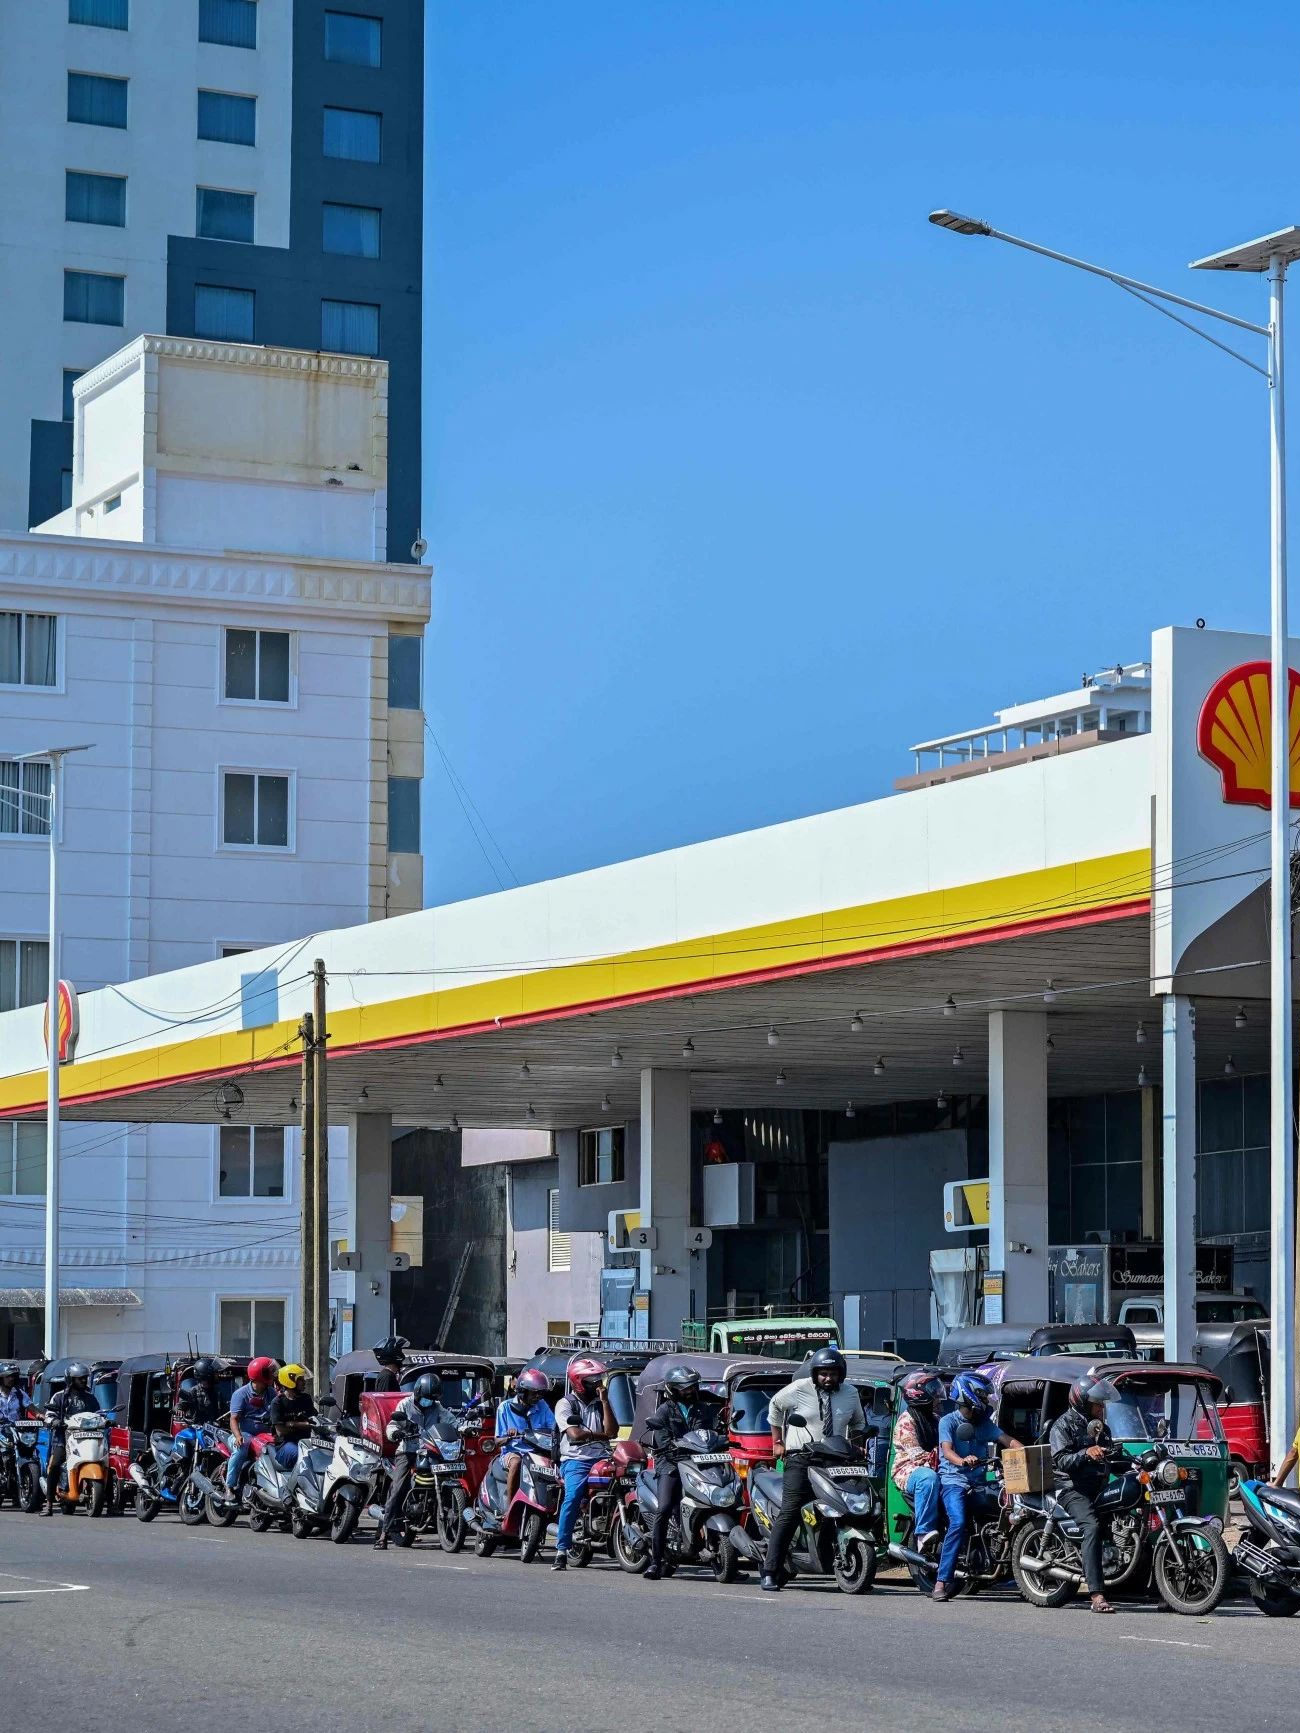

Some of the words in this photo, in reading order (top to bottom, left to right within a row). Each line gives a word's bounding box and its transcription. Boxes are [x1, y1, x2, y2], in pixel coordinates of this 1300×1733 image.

[639, 1232, 648, 1245] 3
[694, 1232, 703, 1244] 4
[395, 1256, 402, 1267] 2
[1061, 1257, 1101, 1277] Bakers
[411, 1356, 435, 1364] 0215
